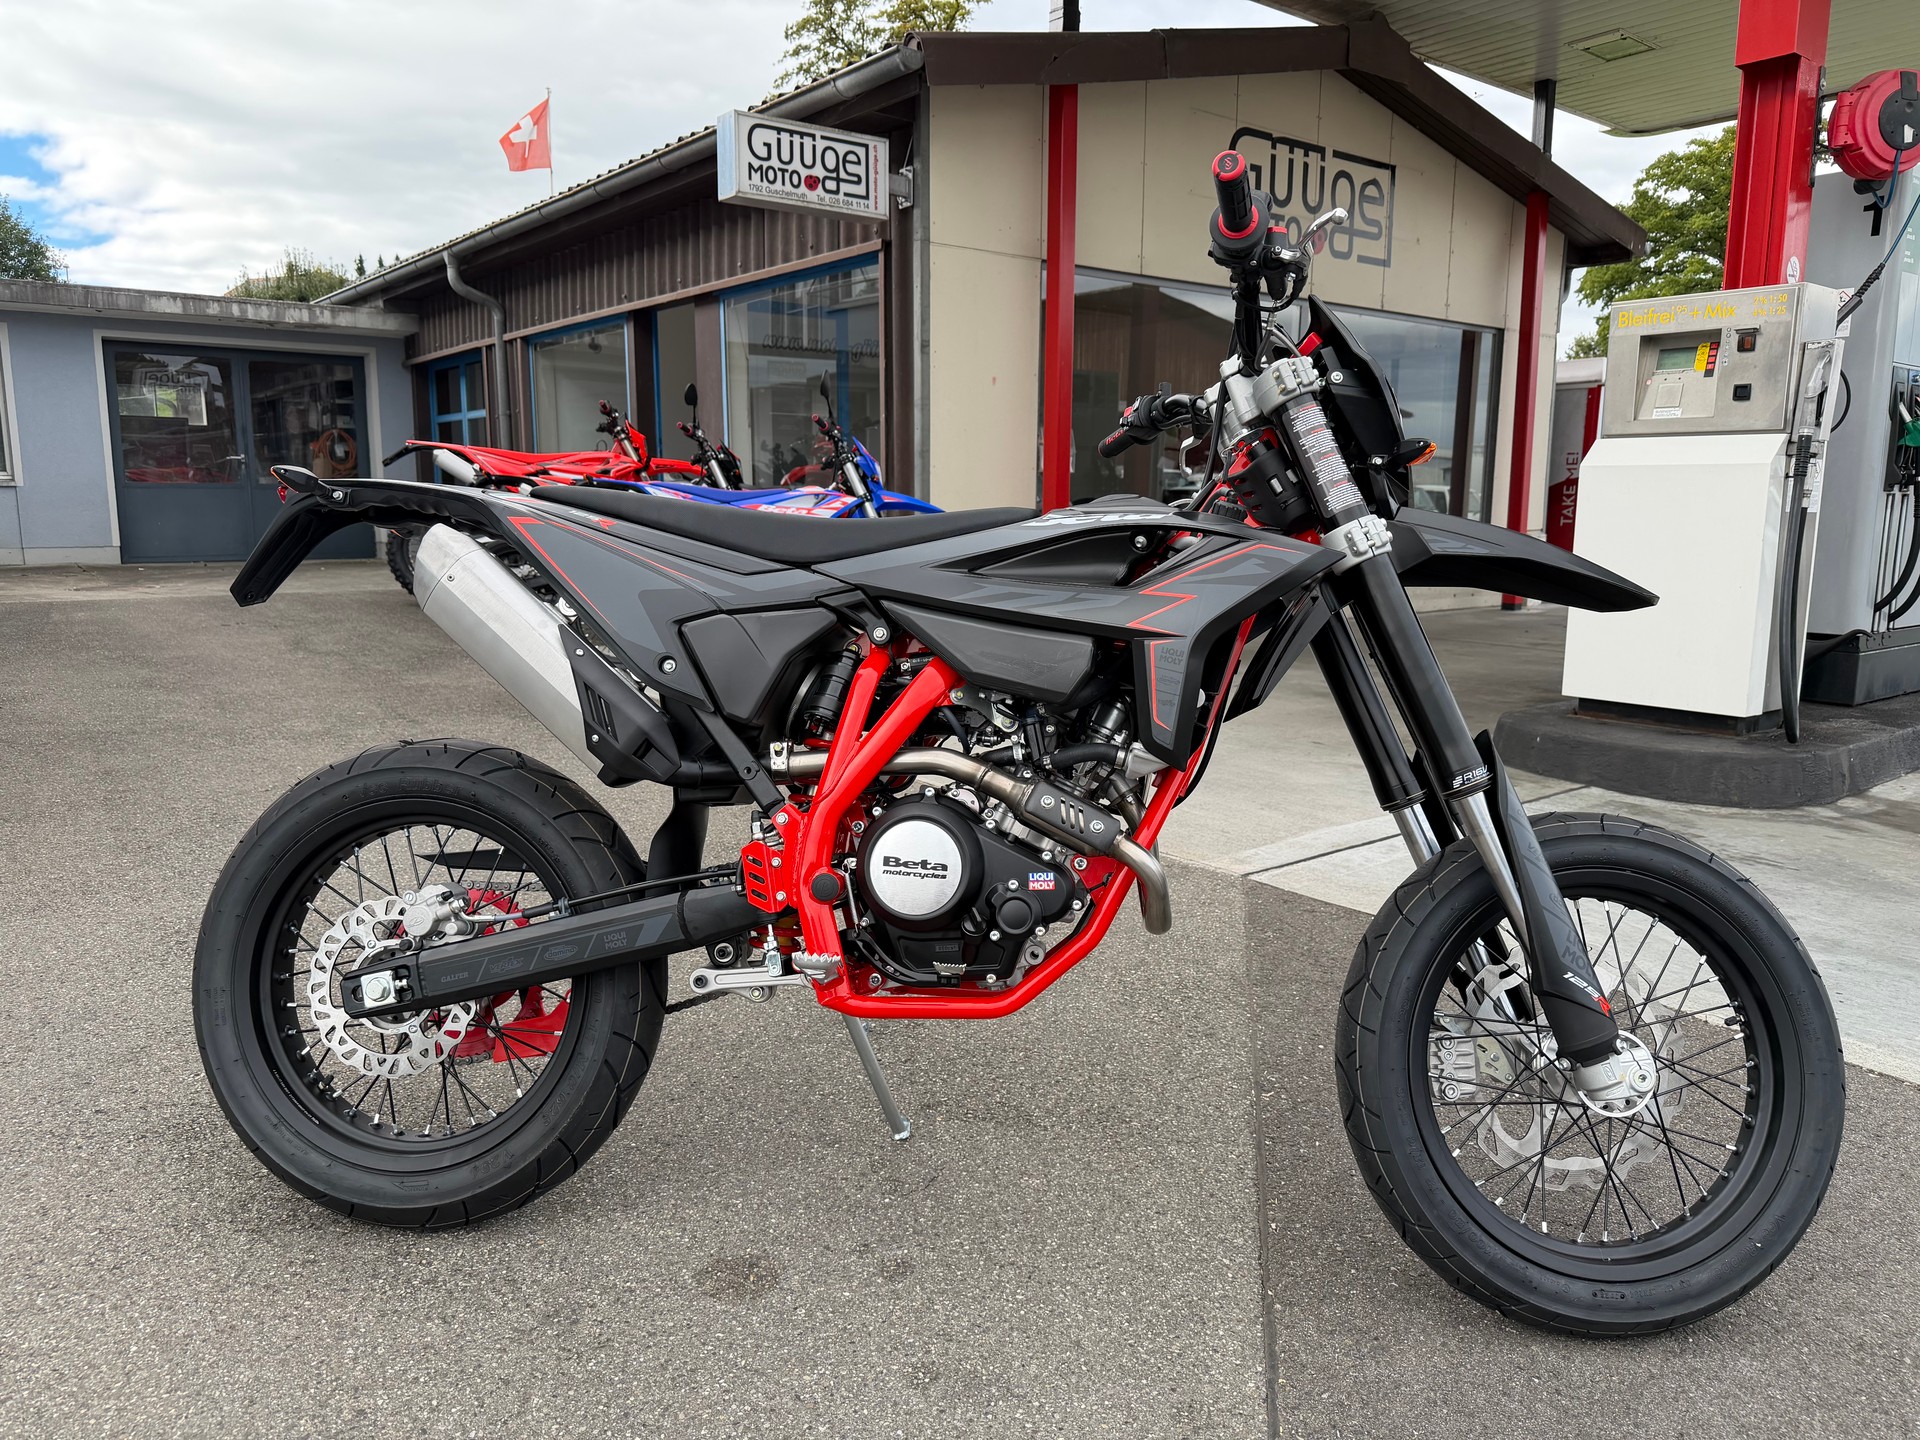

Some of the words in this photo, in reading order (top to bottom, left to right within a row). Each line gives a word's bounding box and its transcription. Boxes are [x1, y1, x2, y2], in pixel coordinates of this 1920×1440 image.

[748, 162, 801, 189] MOTO
[748, 183, 764, 193] 1792
[765, 185, 808, 200] Guschelmuth
[816, 194, 827, 203] Tel.
[828, 196, 841, 206] 026
[855, 200, 862, 209] 11
[863, 201, 870, 210] 14
[1703, 300, 1738, 320] Mix
[1566, 452, 1580, 480] ME!
[1559, 485, 1577, 527] TAKE
[1161, 646, 1185, 658] LIQUI
[1159, 654, 1184, 665] MOLY
[882, 855, 949, 872] Beta
[882, 869, 948, 880] motorcycles
[1029, 873, 1054, 882] LIQUI
[1029, 881, 1055, 890] MOLY
[603, 931, 627, 942] LIQUI
[605, 938, 628, 950] MOLY
[441, 971, 469, 983] GALFER
